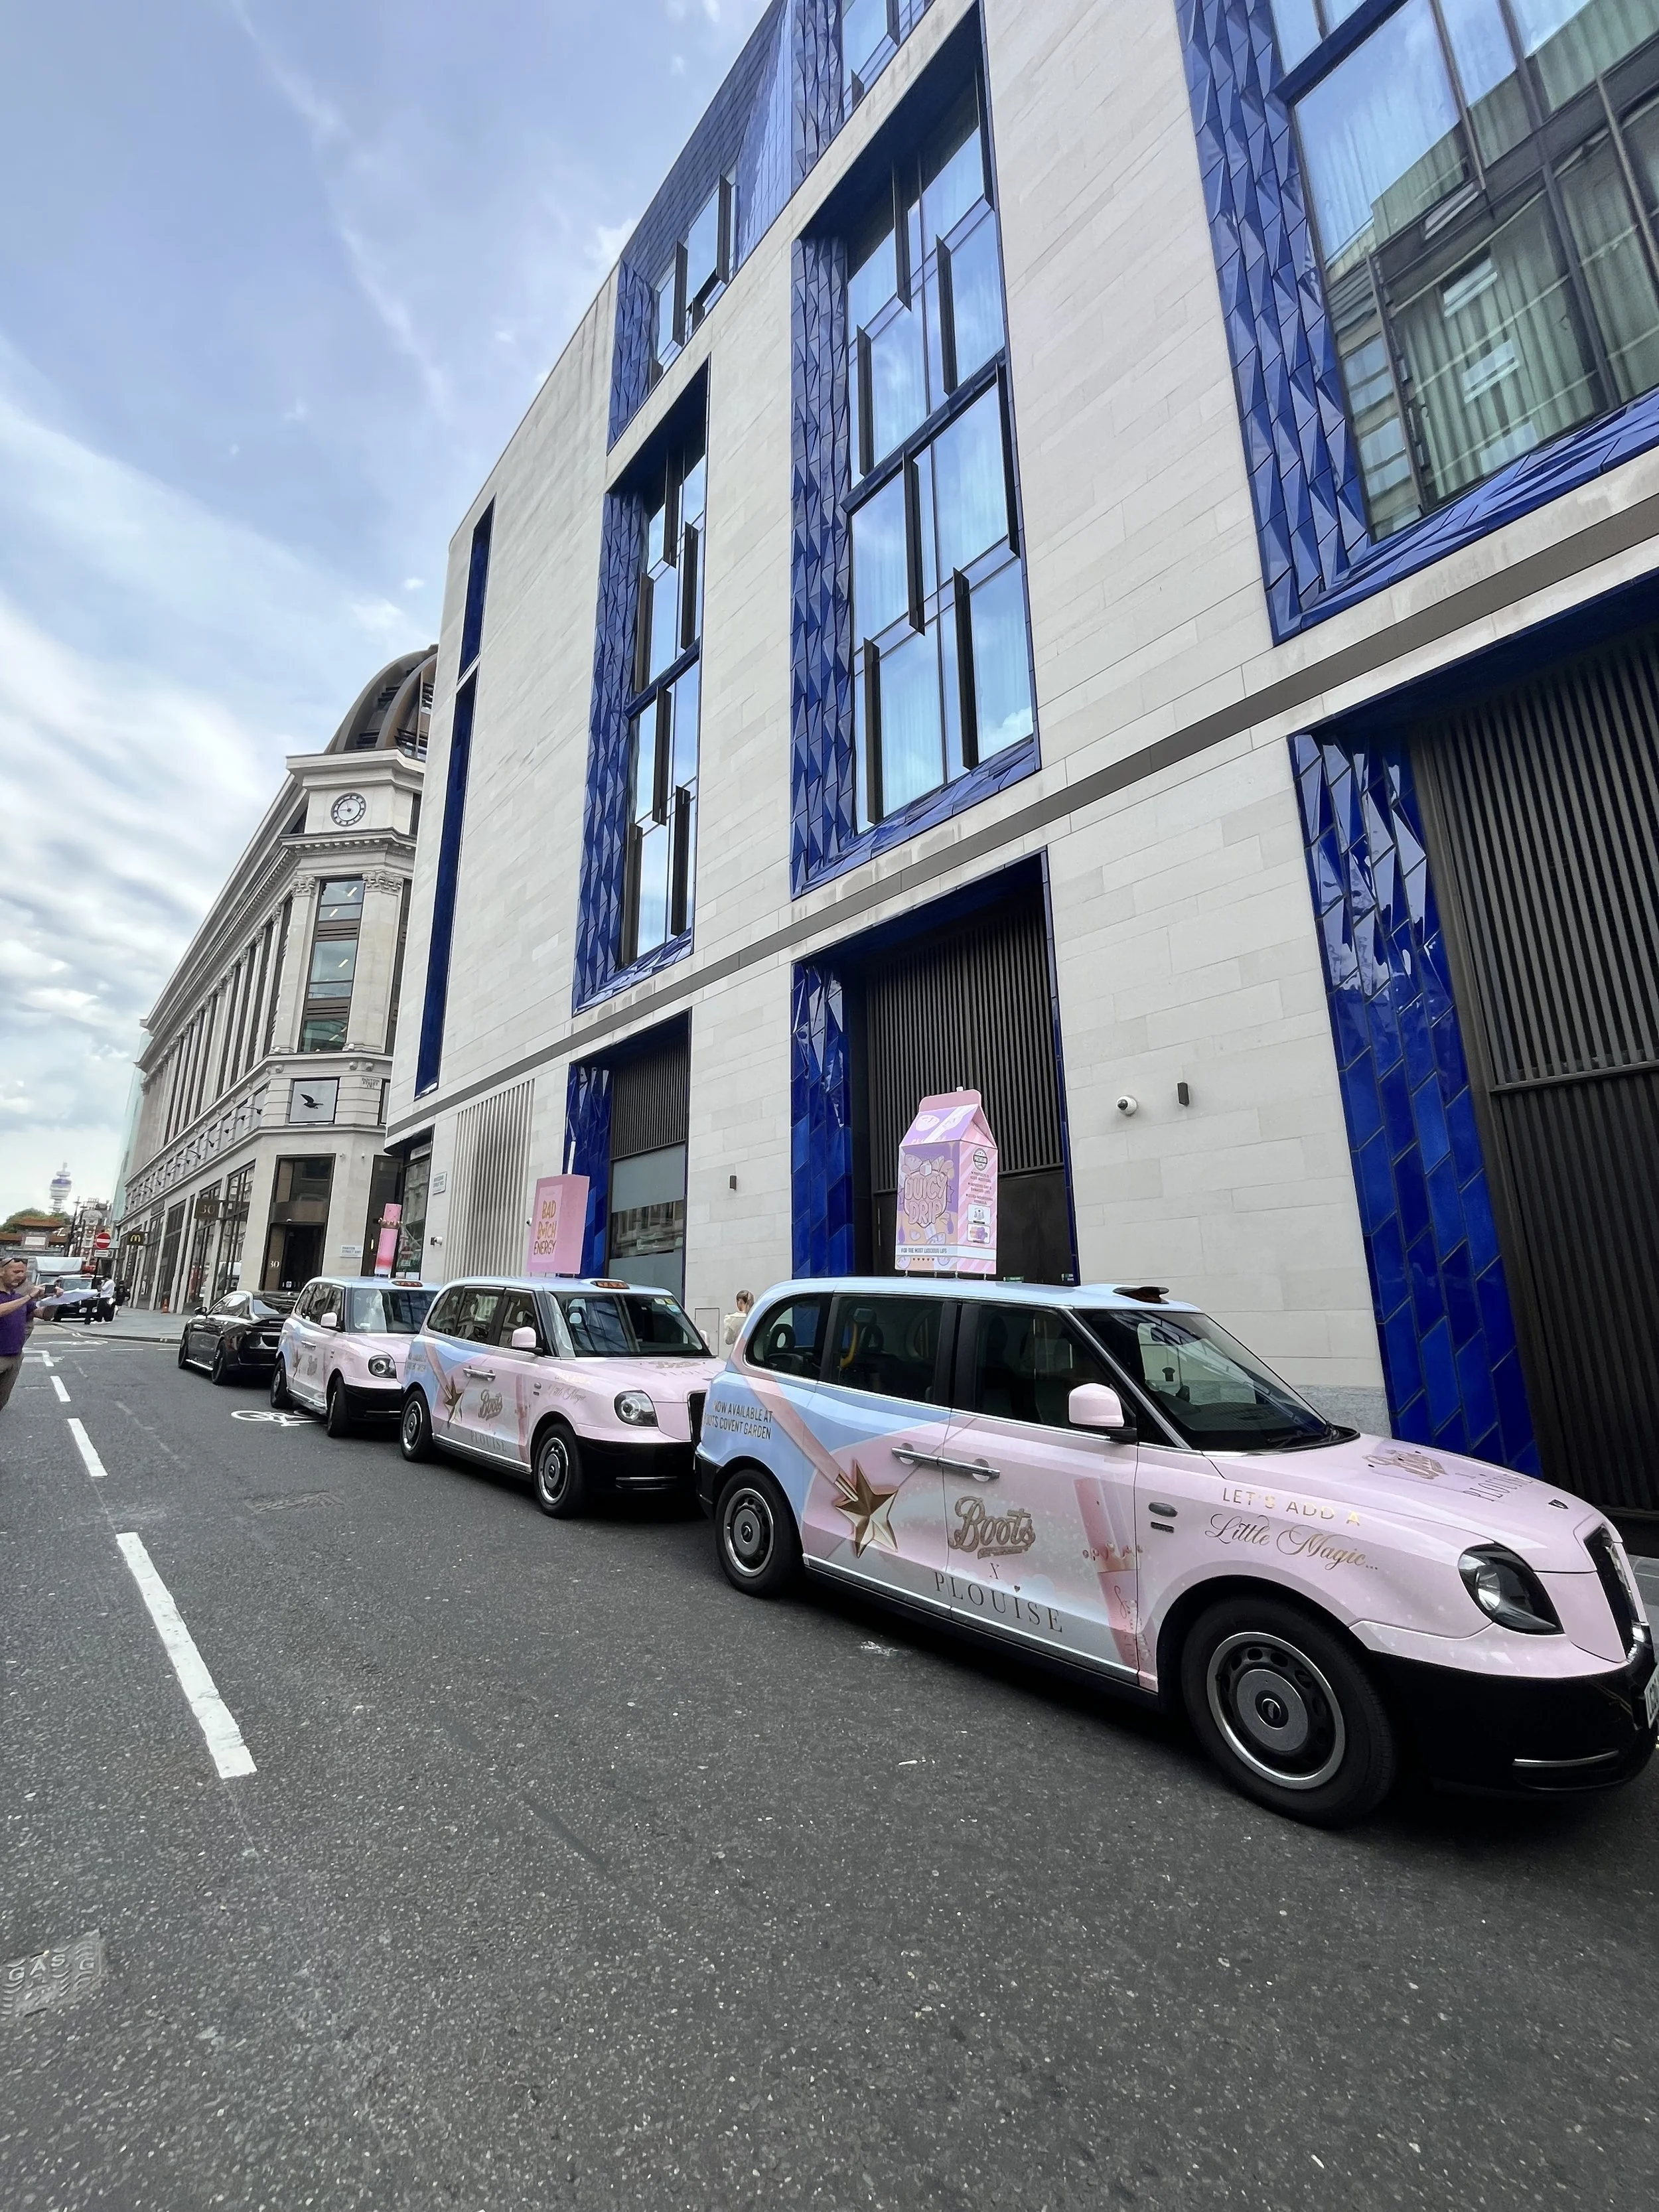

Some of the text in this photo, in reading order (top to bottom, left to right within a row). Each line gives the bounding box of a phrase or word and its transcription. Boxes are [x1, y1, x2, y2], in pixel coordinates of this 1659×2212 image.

[904, 1173, 948, 1201] JUICY
[200, 1204, 216, 1215] 30
[541, 1199, 556, 1220] BAD
[908, 1200, 943, 1225] DRIP
[533, 1239, 557, 1256] ENERGY
[728, 1404, 763, 1421] AVAILABLE
[764, 1410, 773, 1424] AT
[719, 1417, 743, 1434] COVENT
[743, 1422, 772, 1439] GARDEN
[1222, 1487, 1360, 1526] LET'S ADD A
[948, 1495, 1037, 1560] Boots
[1204, 1513, 1271, 1545] Little
[933, 1571, 1062, 1633] PLOUISE
[8, 1954, 66, 1982] GAS
